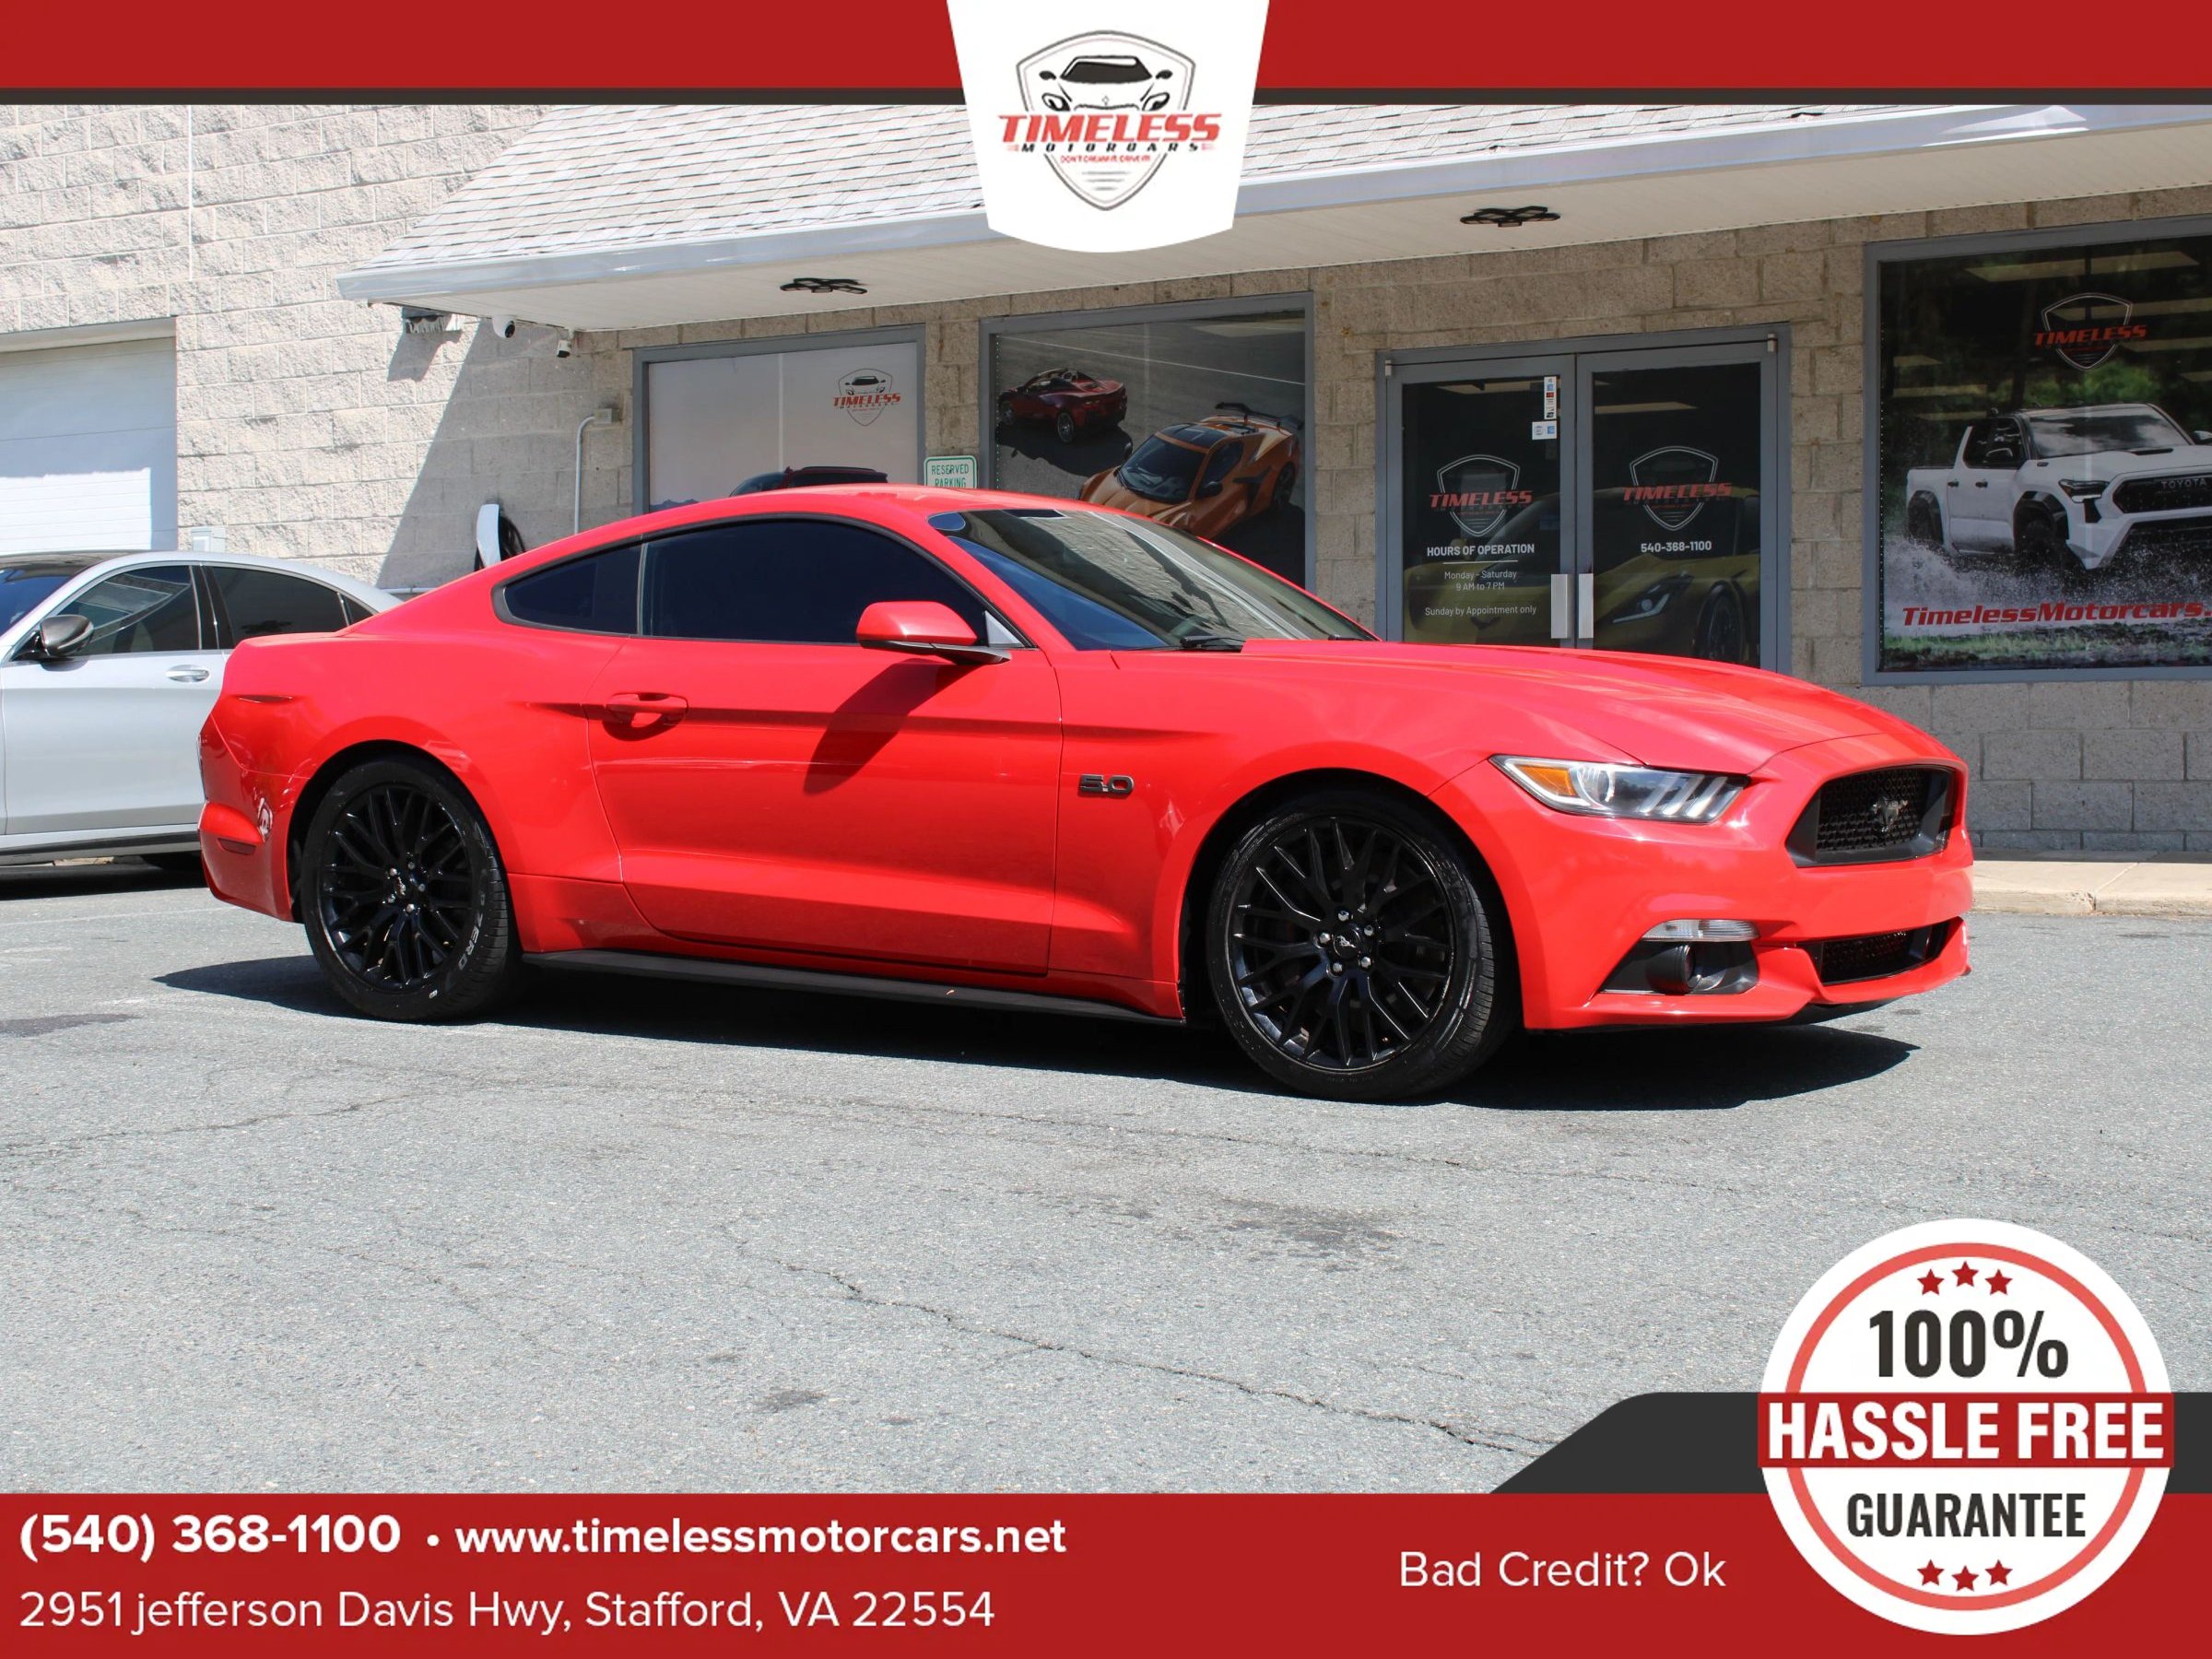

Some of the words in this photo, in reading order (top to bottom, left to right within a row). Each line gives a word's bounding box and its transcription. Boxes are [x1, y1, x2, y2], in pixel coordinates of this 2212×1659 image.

[2034, 324, 2147, 346] TIMELESS
[833, 394, 901, 406] TIMELESS
[931, 464, 969, 475] RESERVED
[935, 477, 966, 488] PARKING
[2160, 477, 2207, 489] TOYOTA
[1622, 483, 1732, 501] TIMELESS
[1430, 490, 1534, 508] TIMELESS
[1427, 547, 1460, 557] HOURS
[1462, 546, 1476, 555] OF
[1477, 544, 1535, 555] OPERATION
[1641, 541, 1712, 552] 540-368-1100
[1444, 571, 1475, 581] Monday
[1481, 570, 1517, 580] Saturday
[1463, 582, 1475, 591] AM
[1477, 582, 1485, 591] to
[1492, 582, 1505, 590] PM
[1425, 606, 1453, 616] Sunday
[1455, 606, 1465, 616] by
[1466, 605, 1518, 616] Appointment
[1520, 605, 1537, 615] only
[1078, 773, 1135, 794] 5.0
